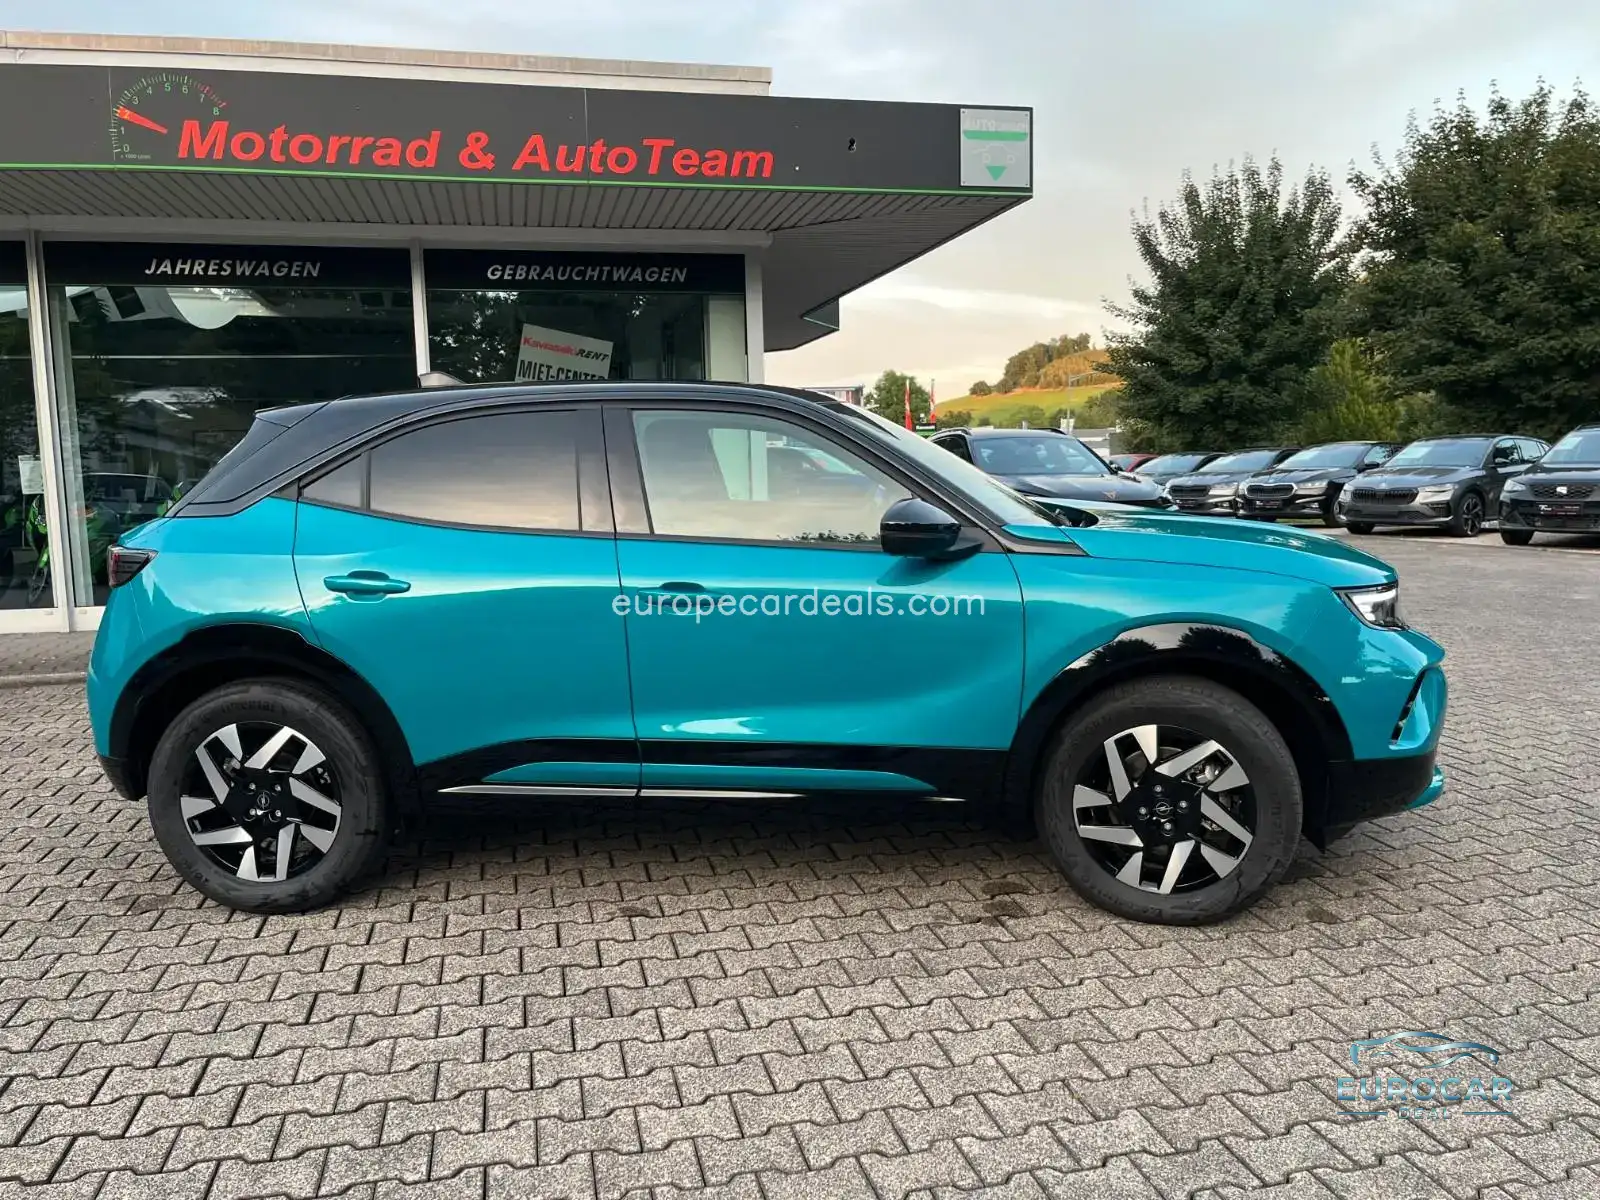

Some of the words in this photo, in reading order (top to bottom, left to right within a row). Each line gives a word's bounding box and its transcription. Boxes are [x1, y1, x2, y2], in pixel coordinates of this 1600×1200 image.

[146, 86, 153, 95] 4
[164, 82, 171, 92] 5
[182, 84, 189, 94] 6
[132, 96, 139, 105] 3
[199, 94, 205, 103] 7
[212, 106, 220, 116] 8
[120, 126, 125, 135] 1
[123, 144, 130, 153] 0
[177, 119, 441, 168] Motorrad
[458, 131, 496, 171] &
[144, 258, 321, 277] JAHRESWAGEN
[486, 264, 688, 283] GEBRAUCHTWAGEN
